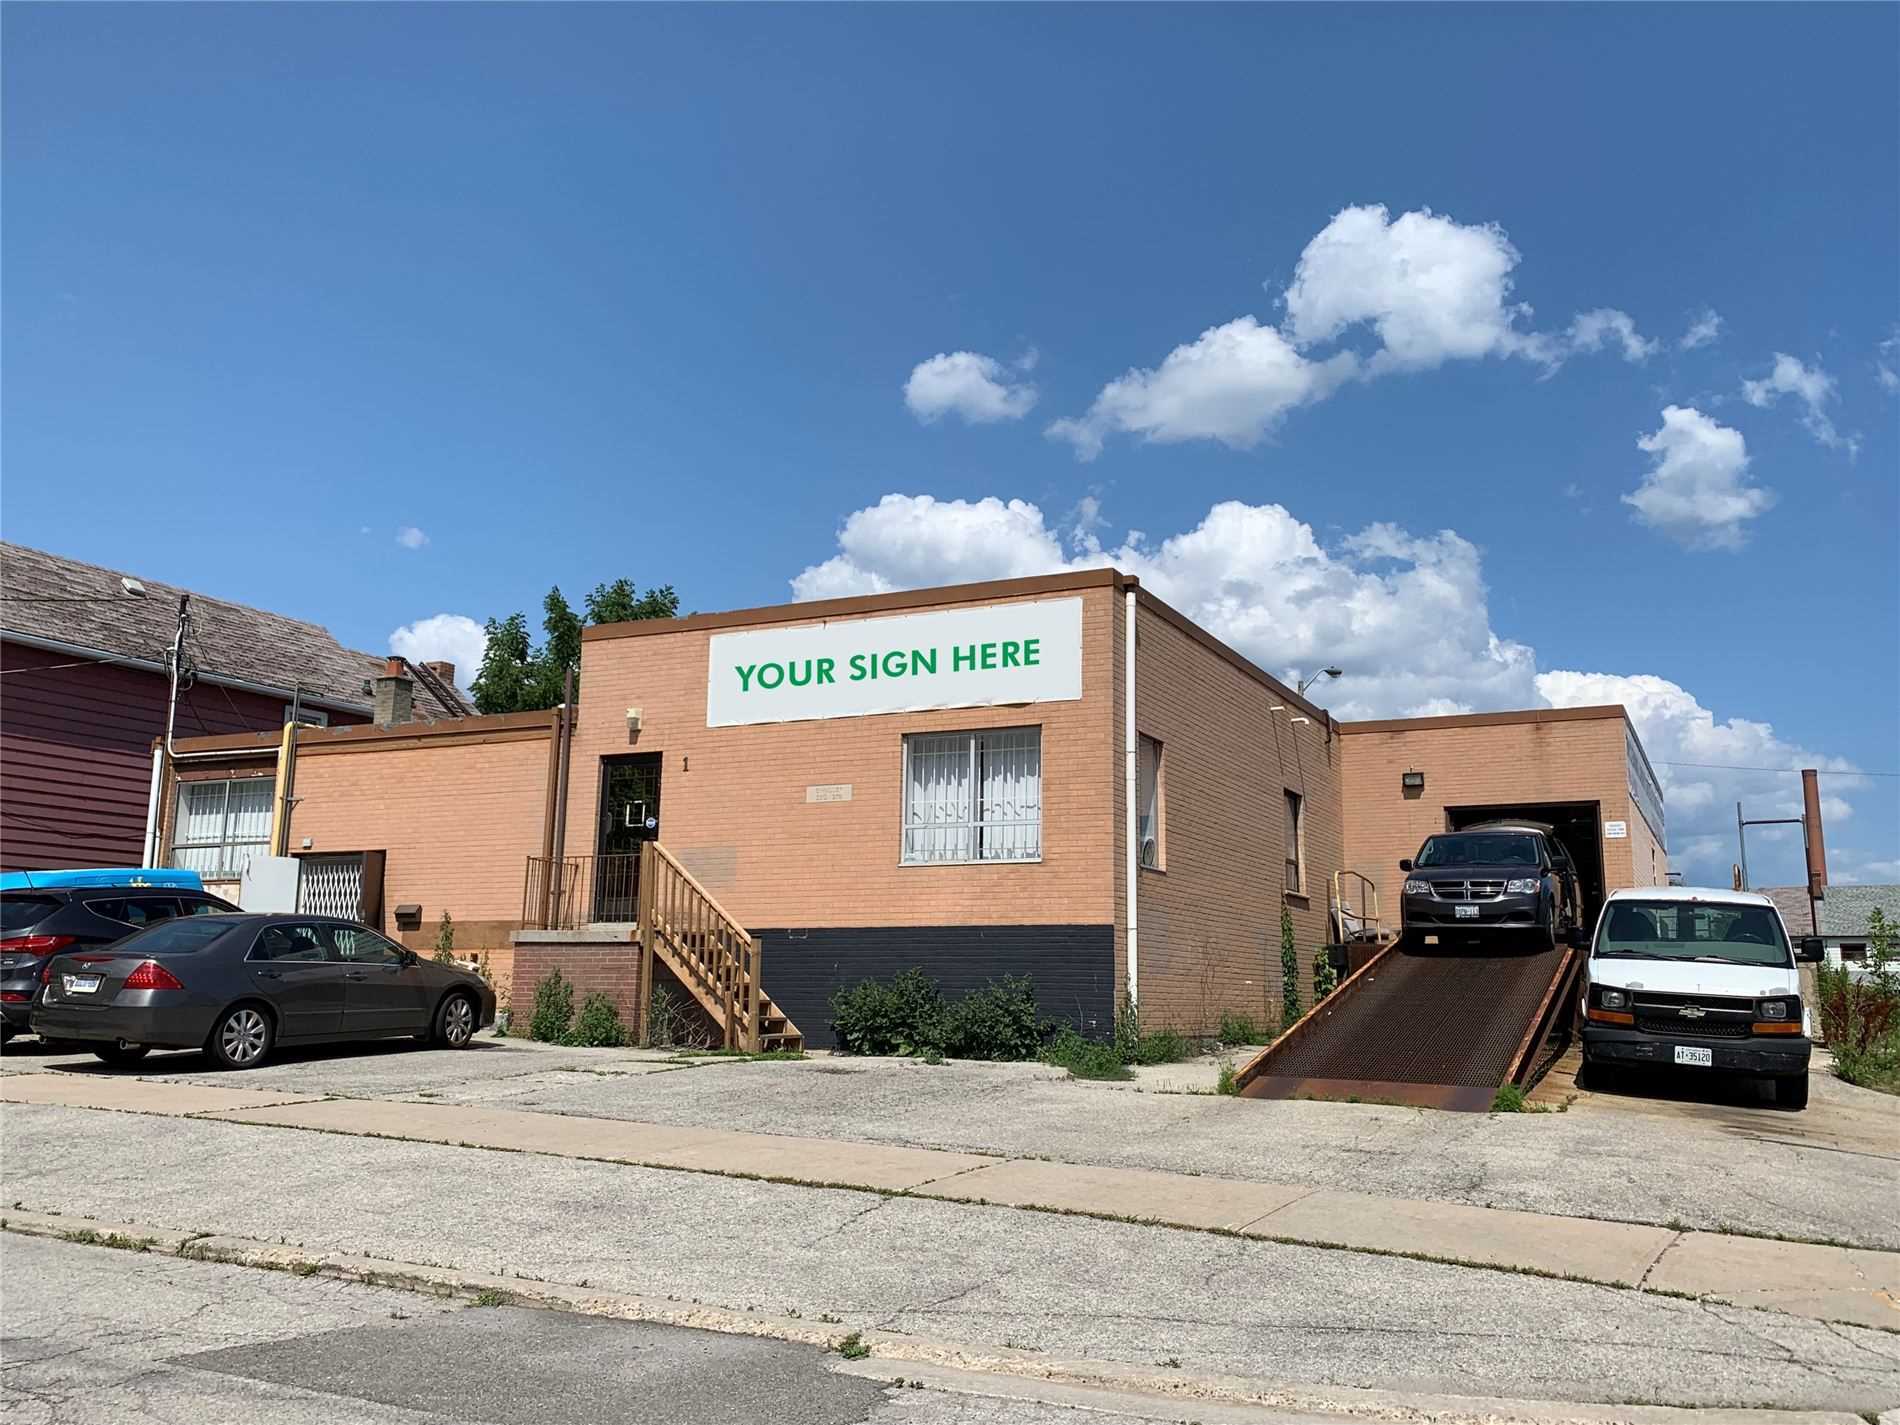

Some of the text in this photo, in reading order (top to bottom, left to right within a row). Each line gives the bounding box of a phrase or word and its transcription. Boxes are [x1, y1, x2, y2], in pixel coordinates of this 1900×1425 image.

[736, 640, 1040, 691] YOUR SIGN HERE
[682, 756, 689, 772] 1
